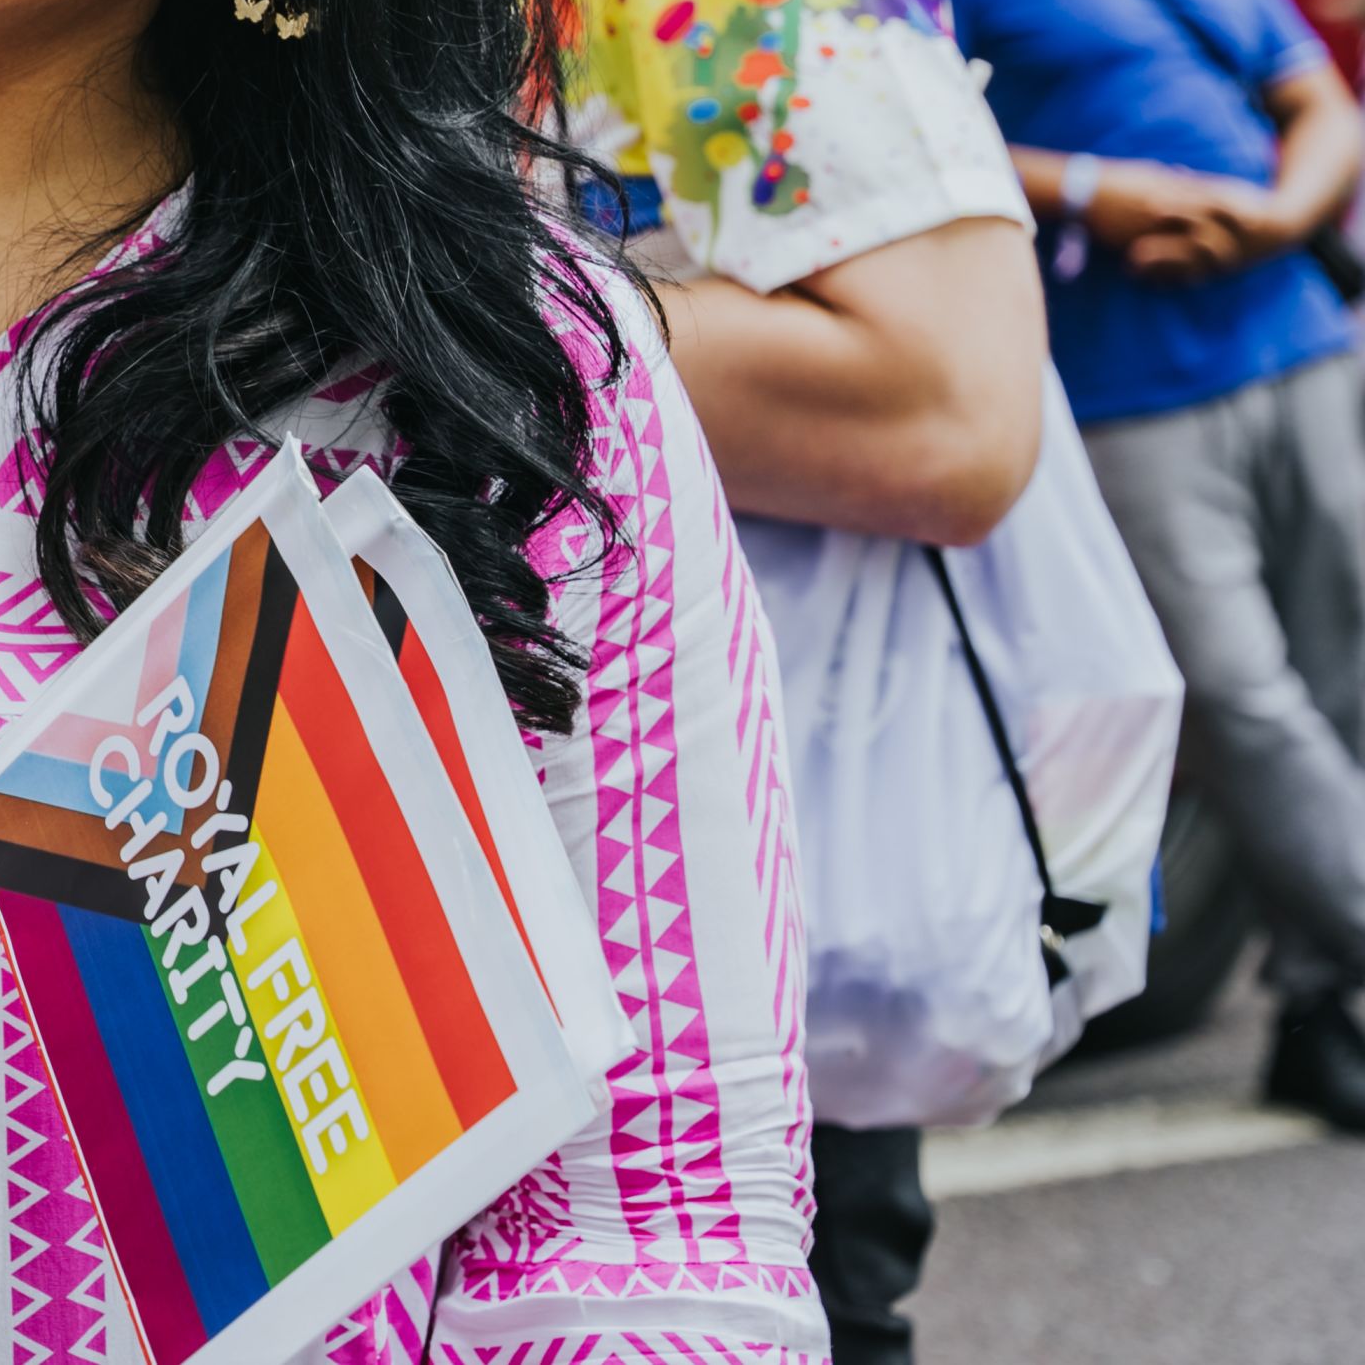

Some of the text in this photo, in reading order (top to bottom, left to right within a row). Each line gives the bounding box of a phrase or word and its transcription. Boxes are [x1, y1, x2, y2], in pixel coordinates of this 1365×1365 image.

[89, 736, 266, 1096] CHARITY
[138, 675, 370, 1176] ROYAL FREE
